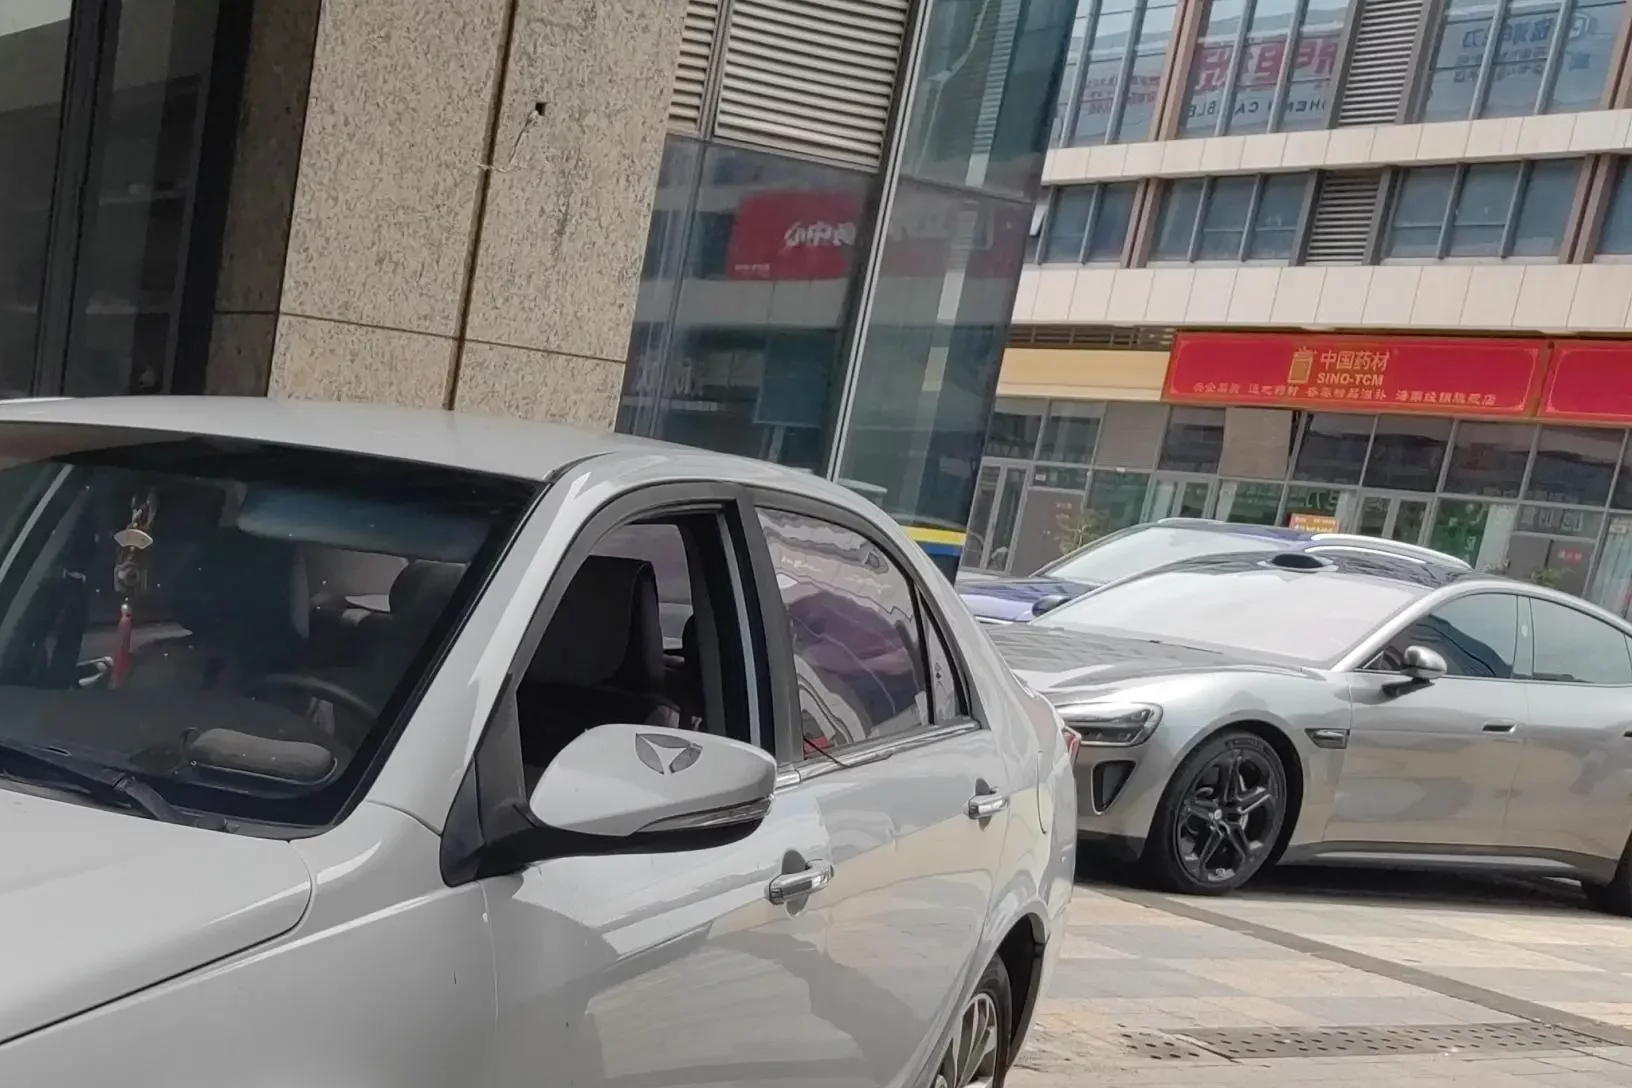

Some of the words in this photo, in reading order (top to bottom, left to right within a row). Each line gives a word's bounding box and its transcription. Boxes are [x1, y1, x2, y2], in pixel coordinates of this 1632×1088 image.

[1319, 348, 1390, 371] 中国药材
[1316, 372, 1385, 386] SINO-TCM
